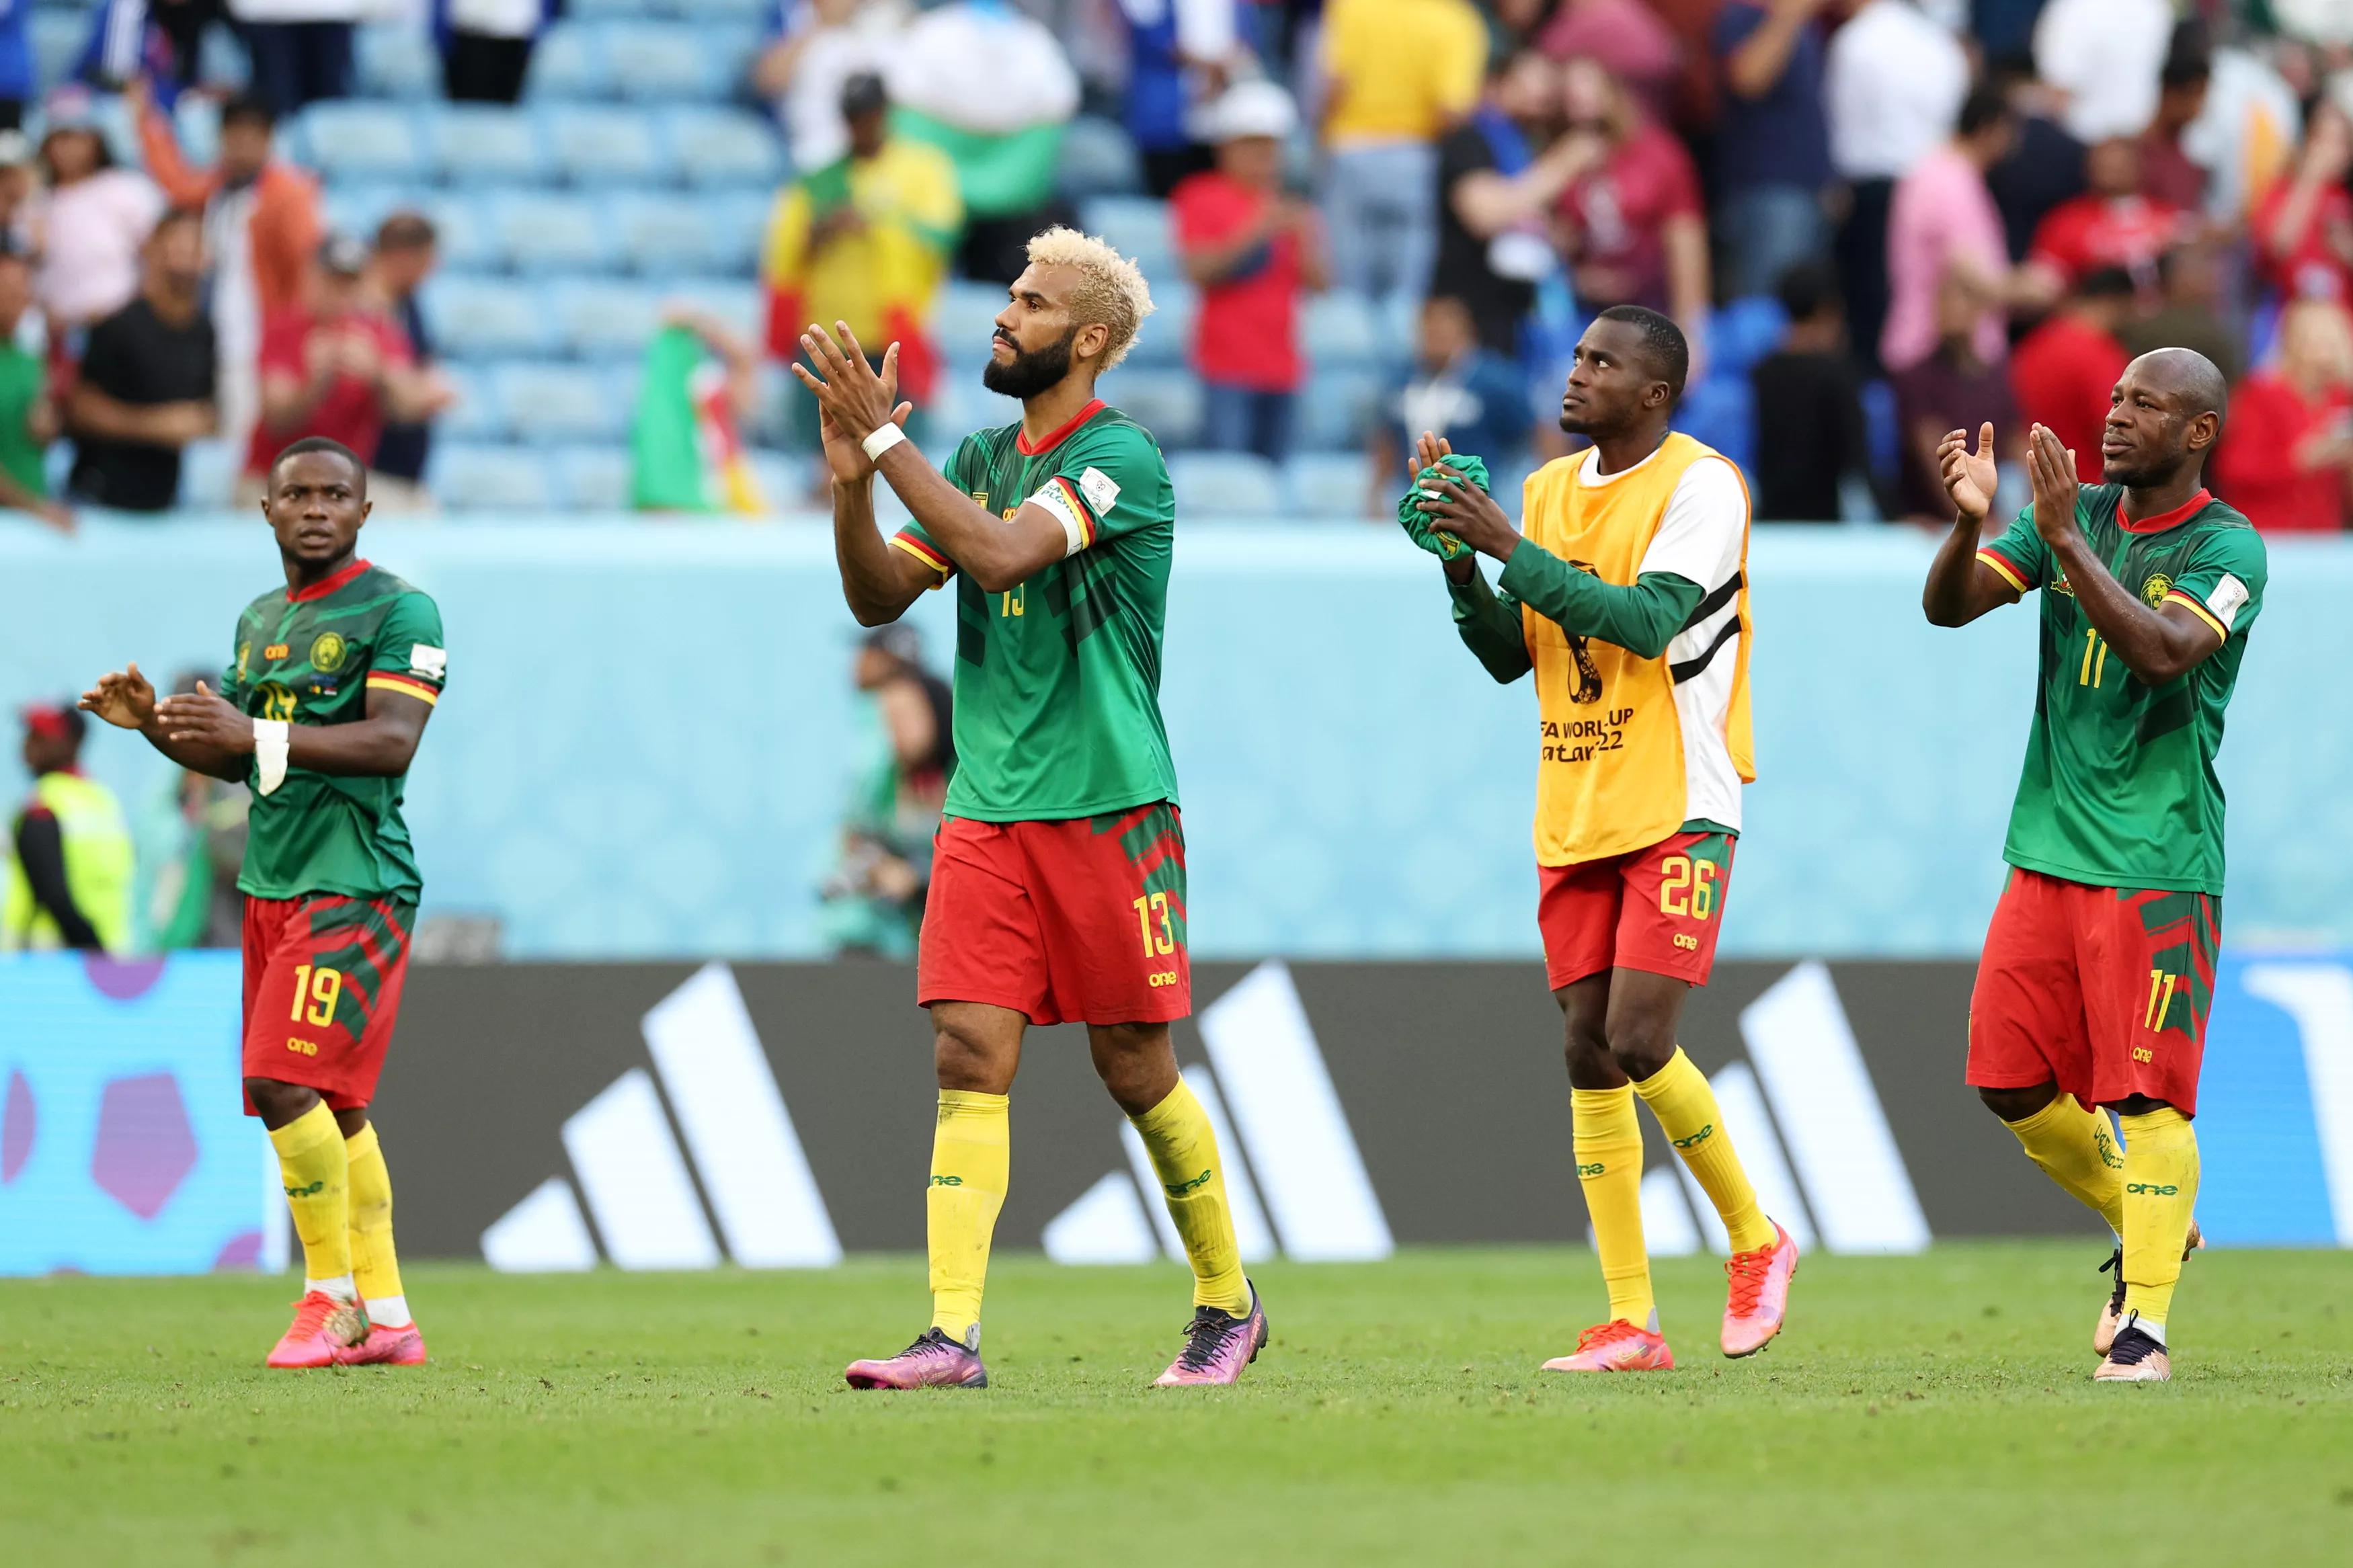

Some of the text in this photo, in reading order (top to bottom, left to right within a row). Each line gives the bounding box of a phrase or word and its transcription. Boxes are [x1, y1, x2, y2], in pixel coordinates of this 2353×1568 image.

[1003, 509, 1016, 522] on
[265, 643, 290, 660] one
[2080, 628, 2108, 688] 11
[1564, 720, 1602, 739] WORL
[1604, 708, 1634, 727] UP
[1542, 743, 1595, 763] atar
[1660, 856, 1715, 921] 26
[1133, 892, 1174, 958] 13
[1673, 933, 1698, 951] one
[1149, 971, 1176, 987] one
[290, 964, 342, 1028] 19
[2144, 969, 2176, 1033] 11
[286, 1037, 318, 1057] one
[2132, 1046, 2152, 1064] one
[1672, 1124, 1712, 1148] one
[1577, 1163, 1605, 1176] ne
[930, 1175, 963, 1186] ne
[1165, 1169, 1211, 1198] one
[2126, 1183, 2178, 1196] one
